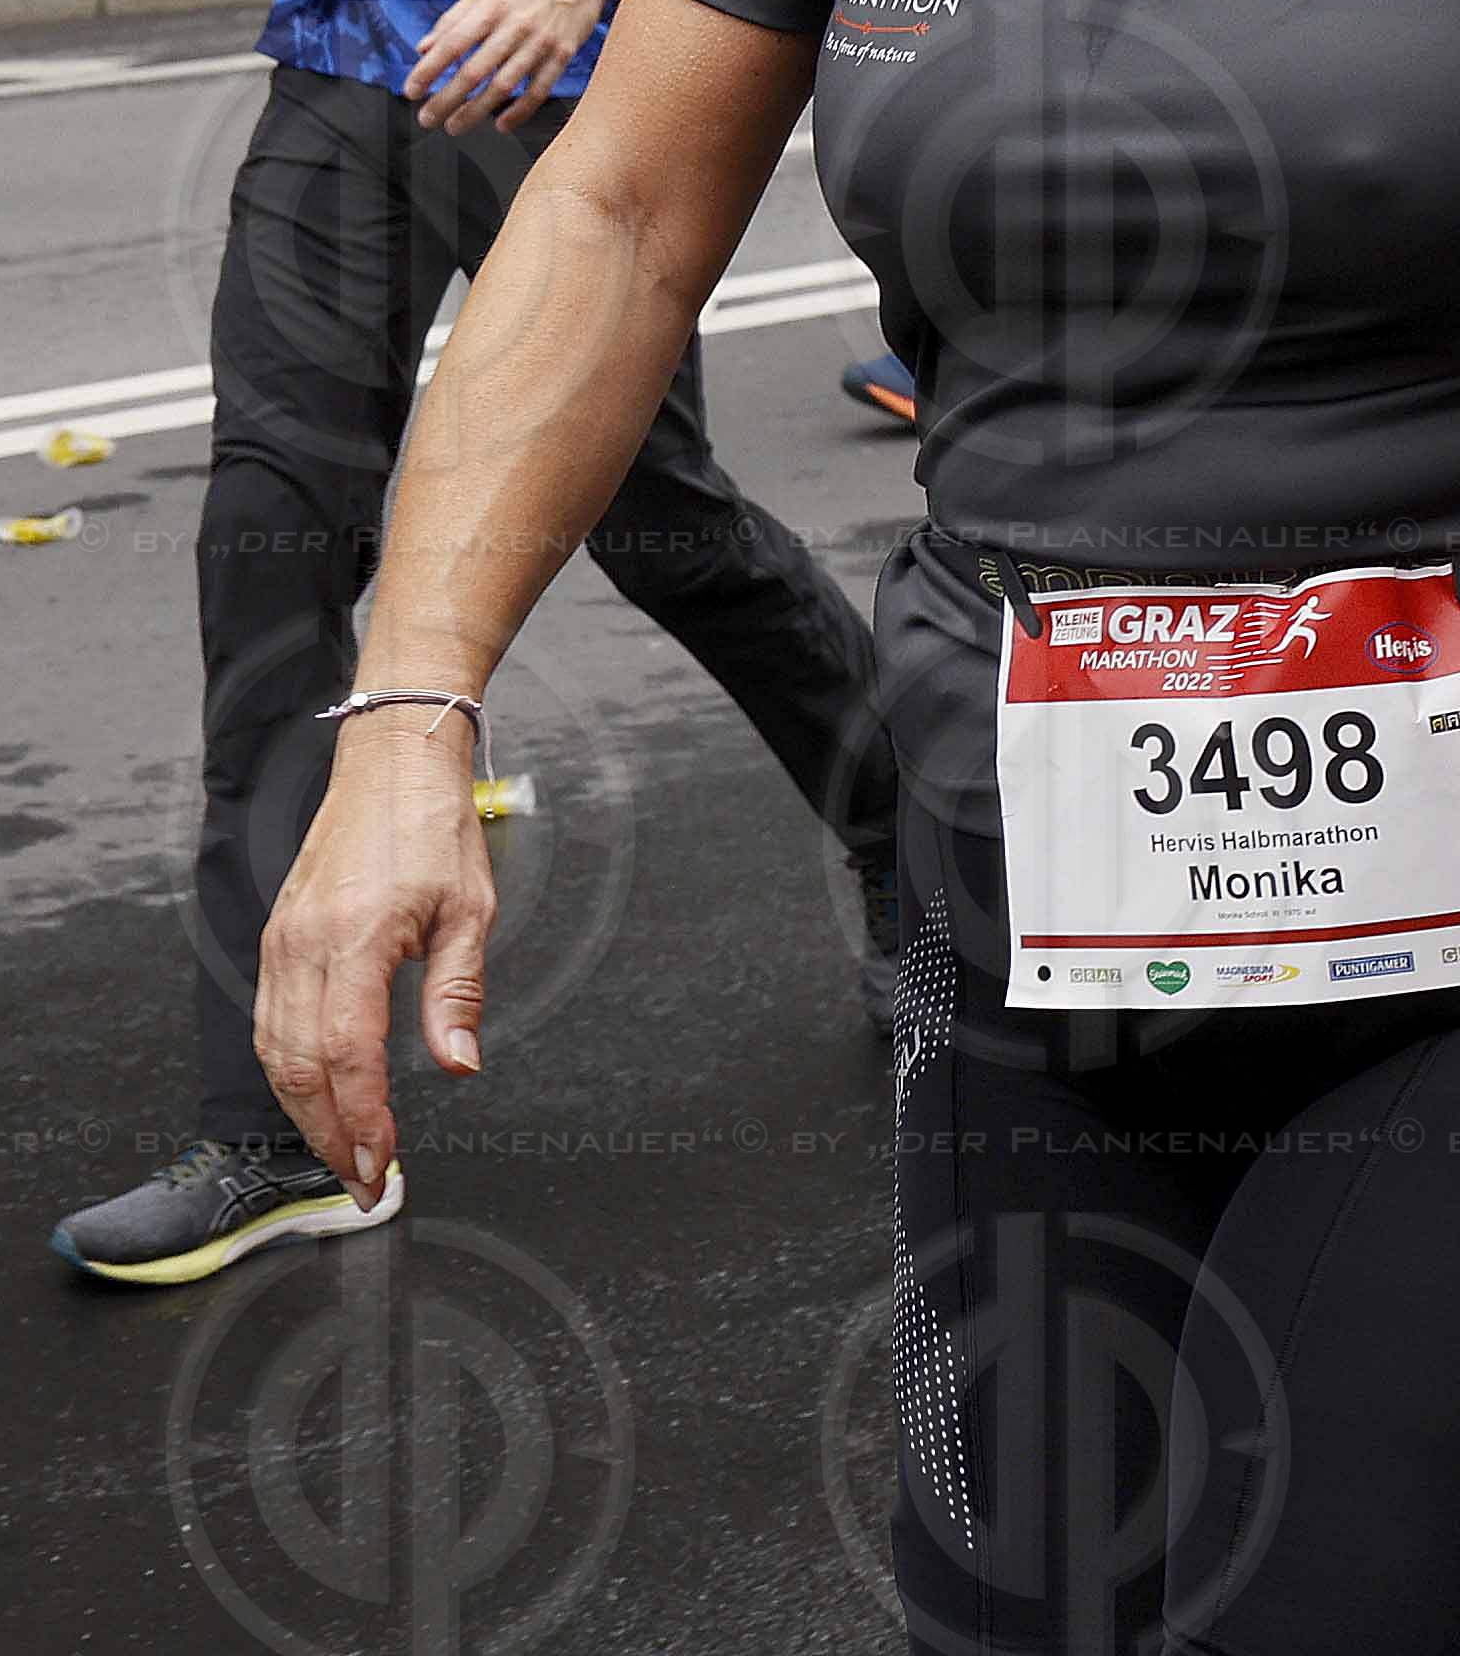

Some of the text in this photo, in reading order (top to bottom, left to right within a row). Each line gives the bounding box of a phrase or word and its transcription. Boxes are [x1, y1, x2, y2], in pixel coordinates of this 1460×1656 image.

[868, 46, 917, 63] nature
[1055, 611, 1100, 625] KLEINE
[1108, 604, 1240, 644] GRAZ
[1054, 625, 1100, 641] ZEITUNG
[1373, 633, 1432, 662] Hervis
[1079, 649, 1198, 670] MARATHON
[1162, 672, 1214, 691] 2022
[1130, 710, 1384, 815] 3498
[1150, 824, 1379, 853] Hervis Halbmarathon
[1188, 860, 1345, 901] Monika
[1070, 968, 1122, 983] GRAZ
[1335, 955, 1409, 977] PUNTIGAMER
[1242, 975, 1274, 983] SPORT
